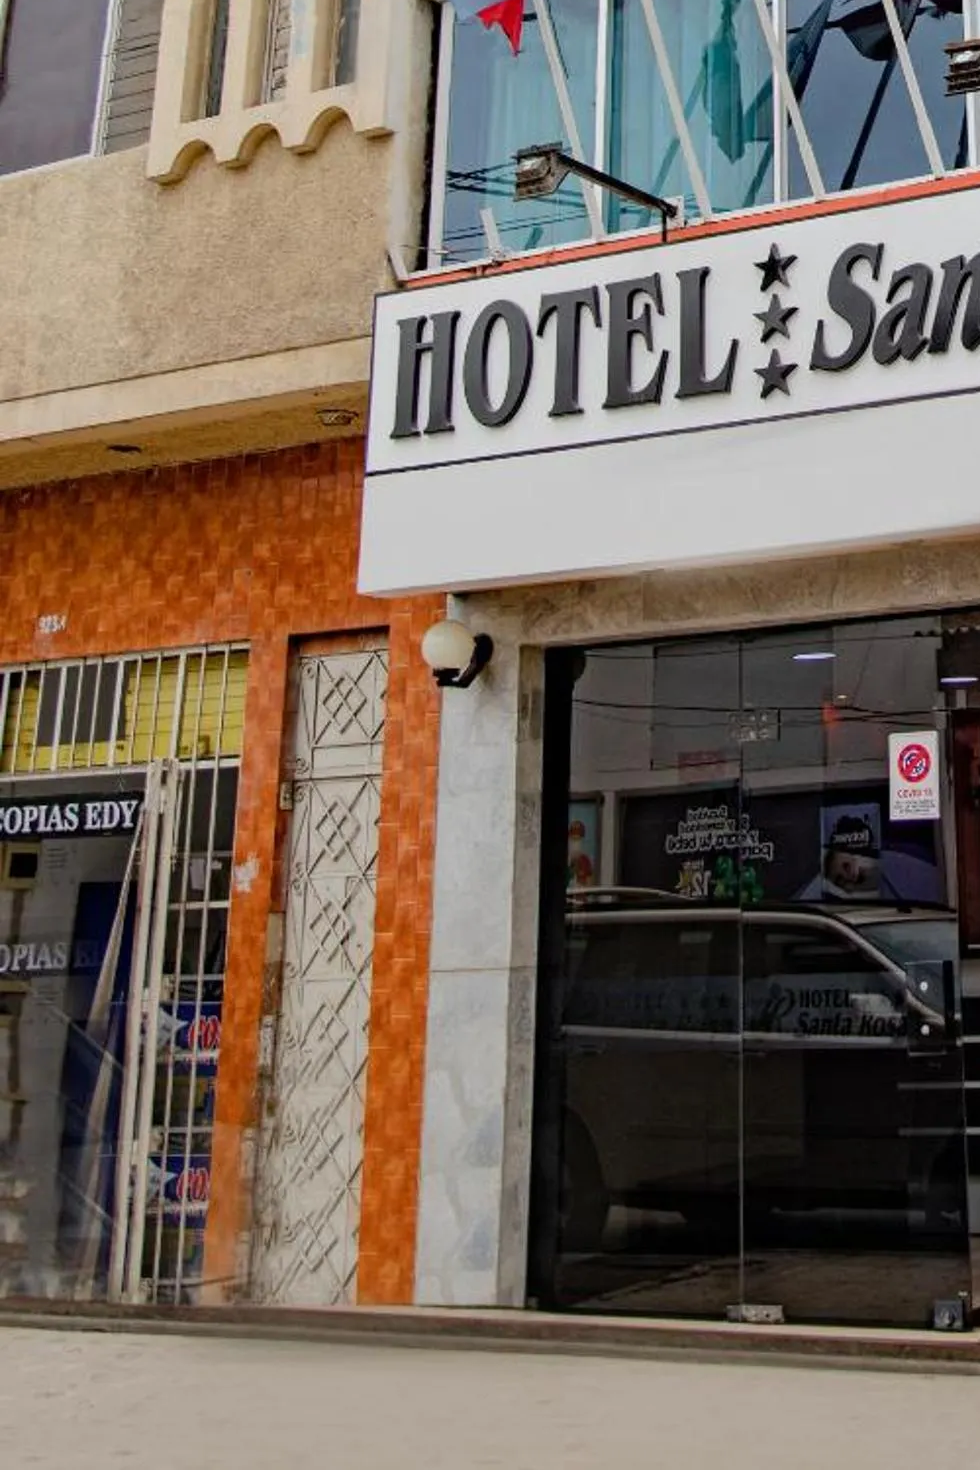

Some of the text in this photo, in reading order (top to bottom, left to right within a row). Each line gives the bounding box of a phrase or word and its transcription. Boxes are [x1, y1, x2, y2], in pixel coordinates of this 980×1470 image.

[390, 266, 739, 440] HOTEL
[0, 800, 139, 834] OPIAS EDY
[796, 1012, 852, 1037] Santa
